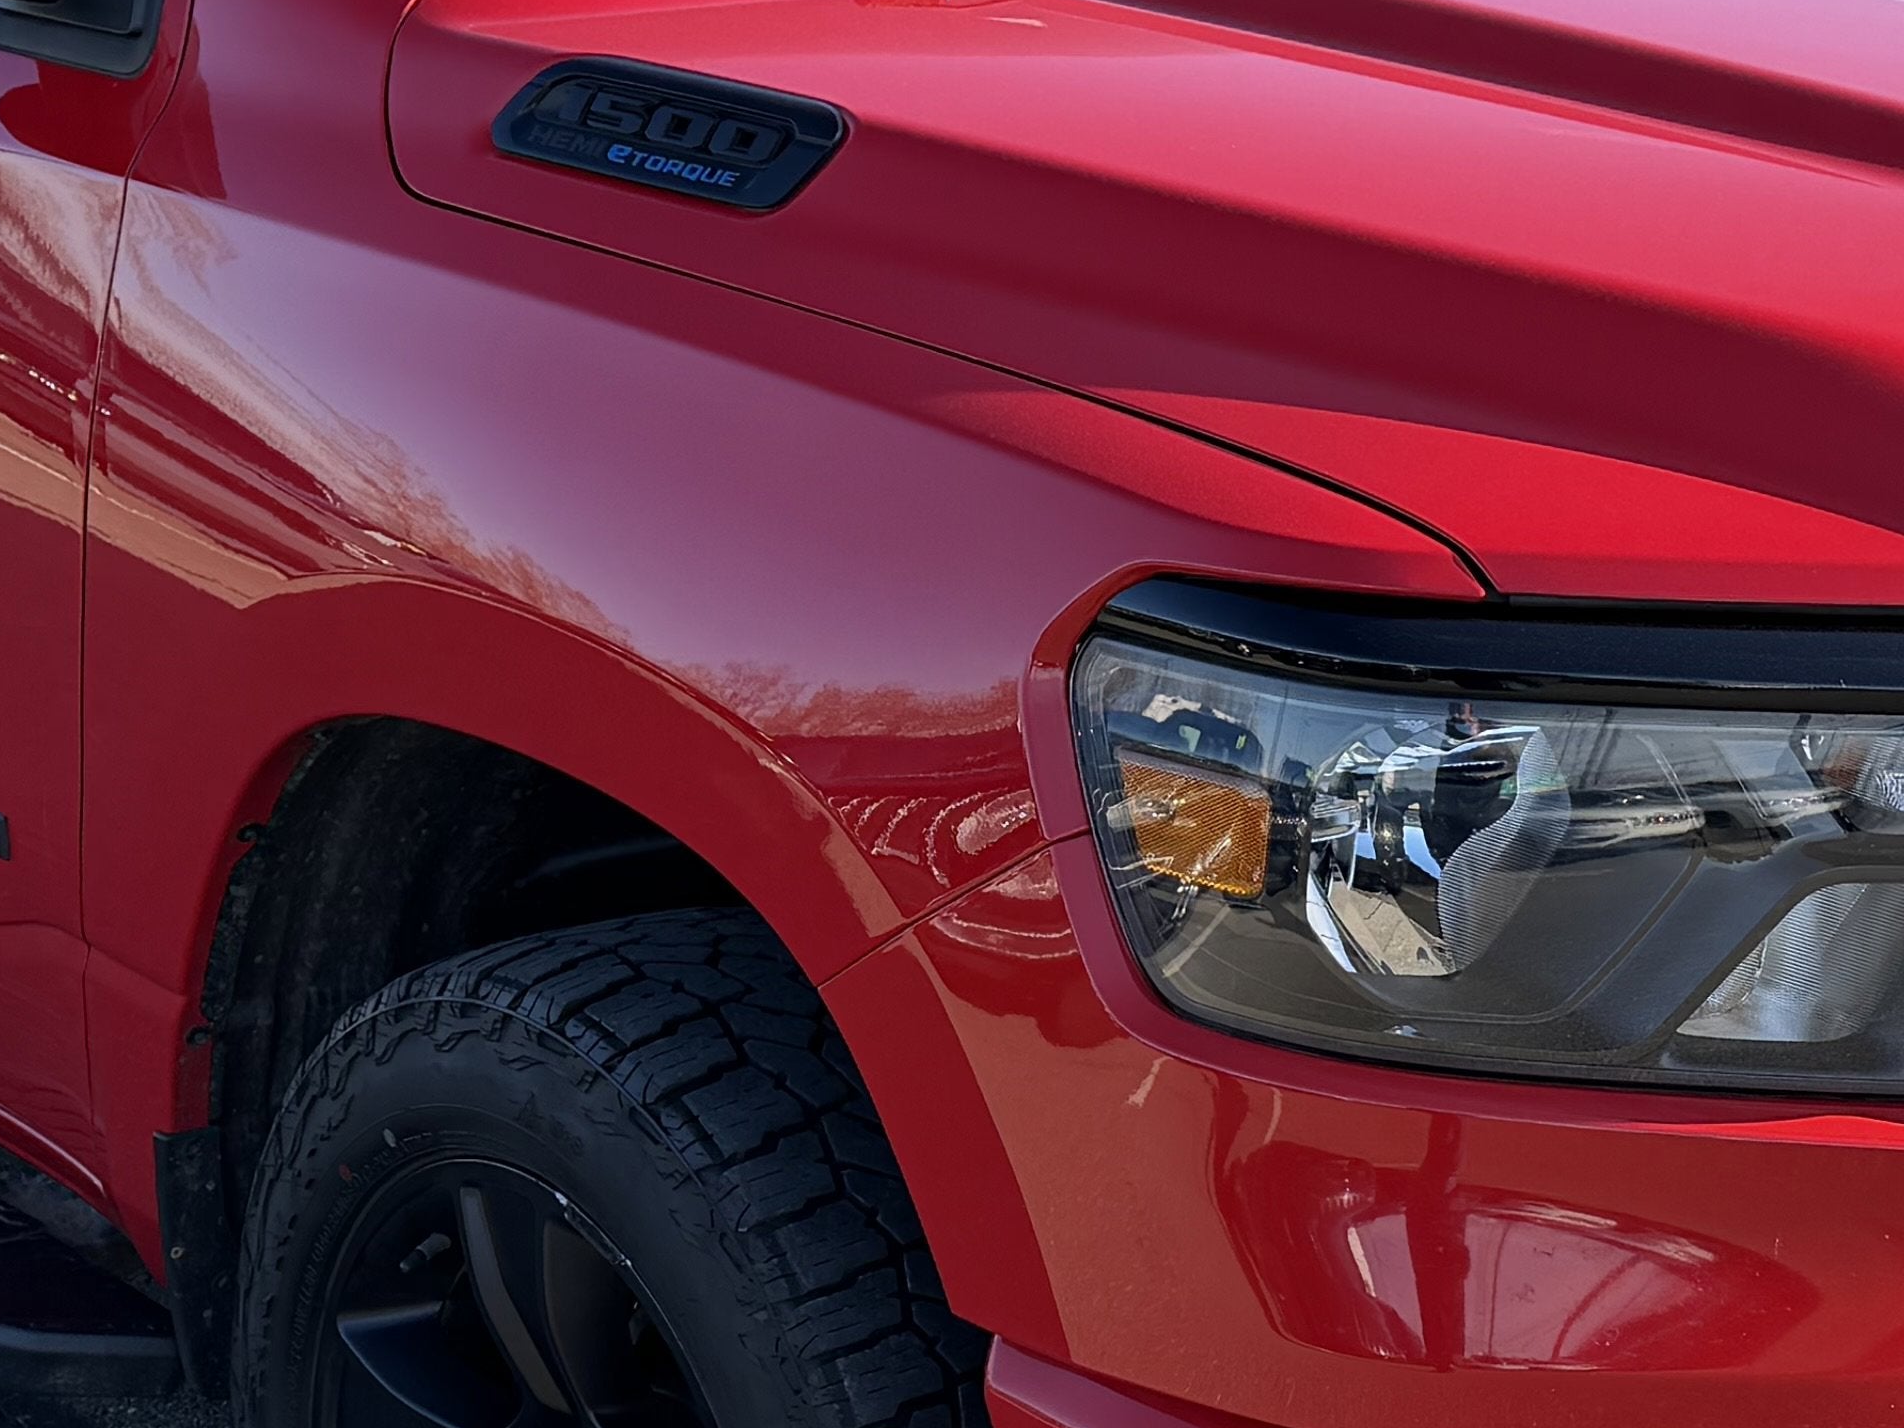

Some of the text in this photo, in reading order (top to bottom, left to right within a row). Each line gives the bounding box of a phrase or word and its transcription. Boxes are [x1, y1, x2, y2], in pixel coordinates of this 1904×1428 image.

[527, 126, 742, 188] HEMI eTORQUE
[534, 80, 784, 162] 1500
